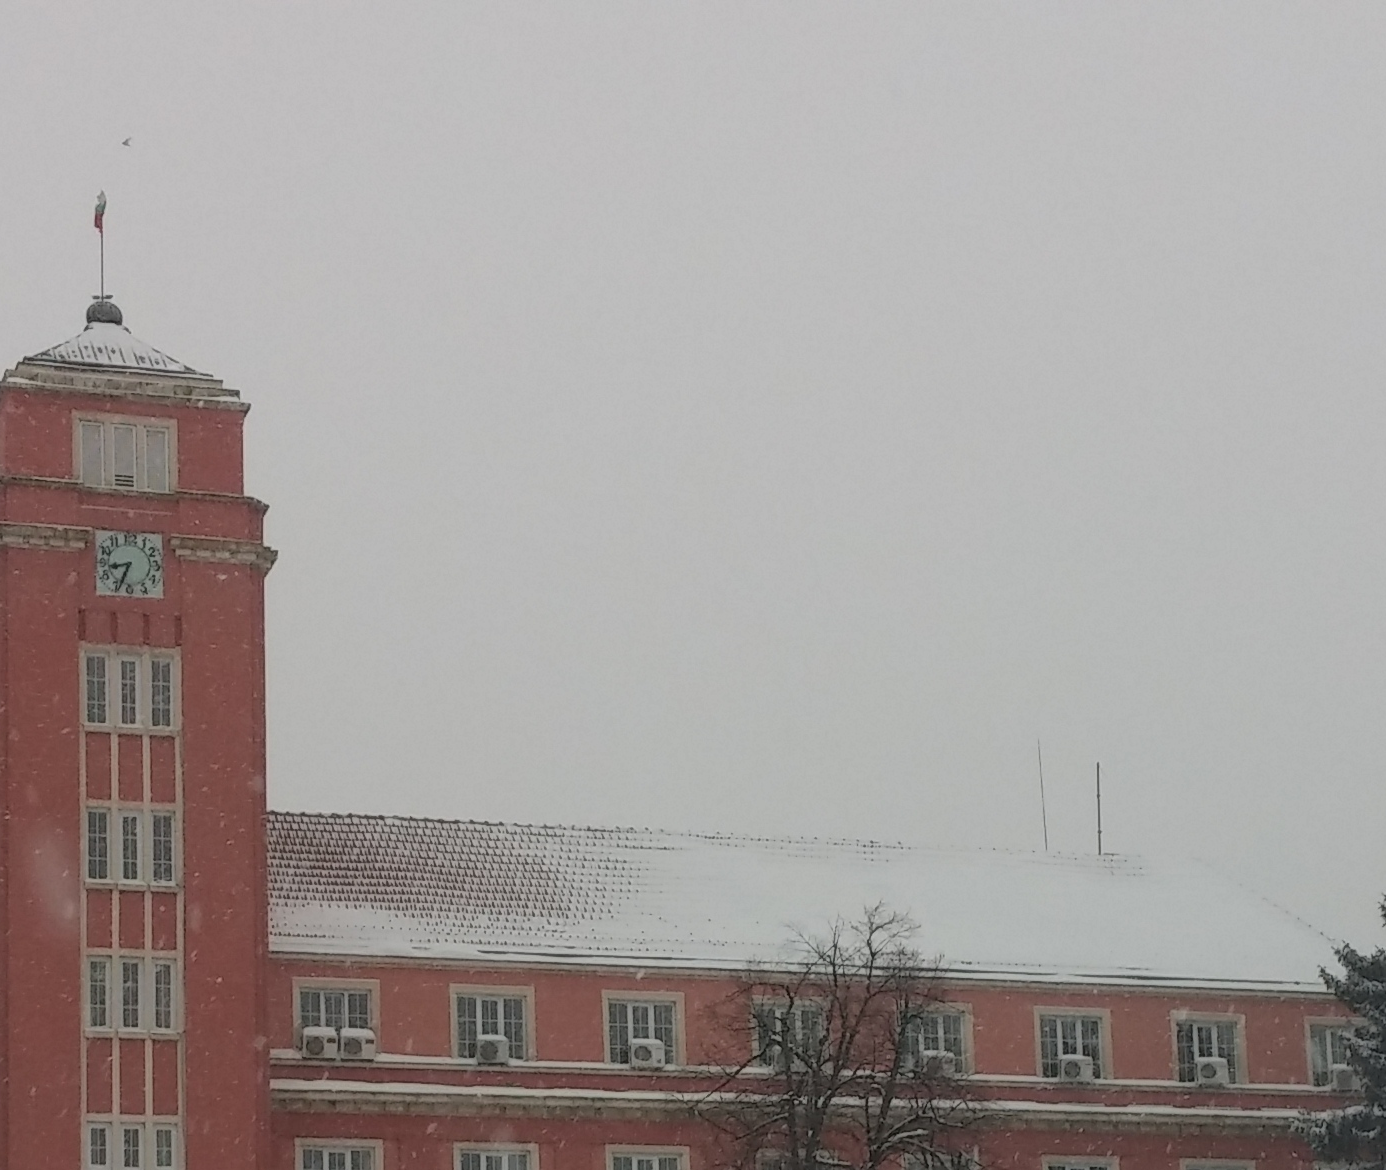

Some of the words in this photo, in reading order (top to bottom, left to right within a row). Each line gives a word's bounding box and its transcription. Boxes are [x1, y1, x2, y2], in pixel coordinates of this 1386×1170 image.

[124, 534, 137, 545] 12
[142, 537, 147, 548] 1
[148, 547, 156, 557] 2
[153, 560, 161, 571] 3
